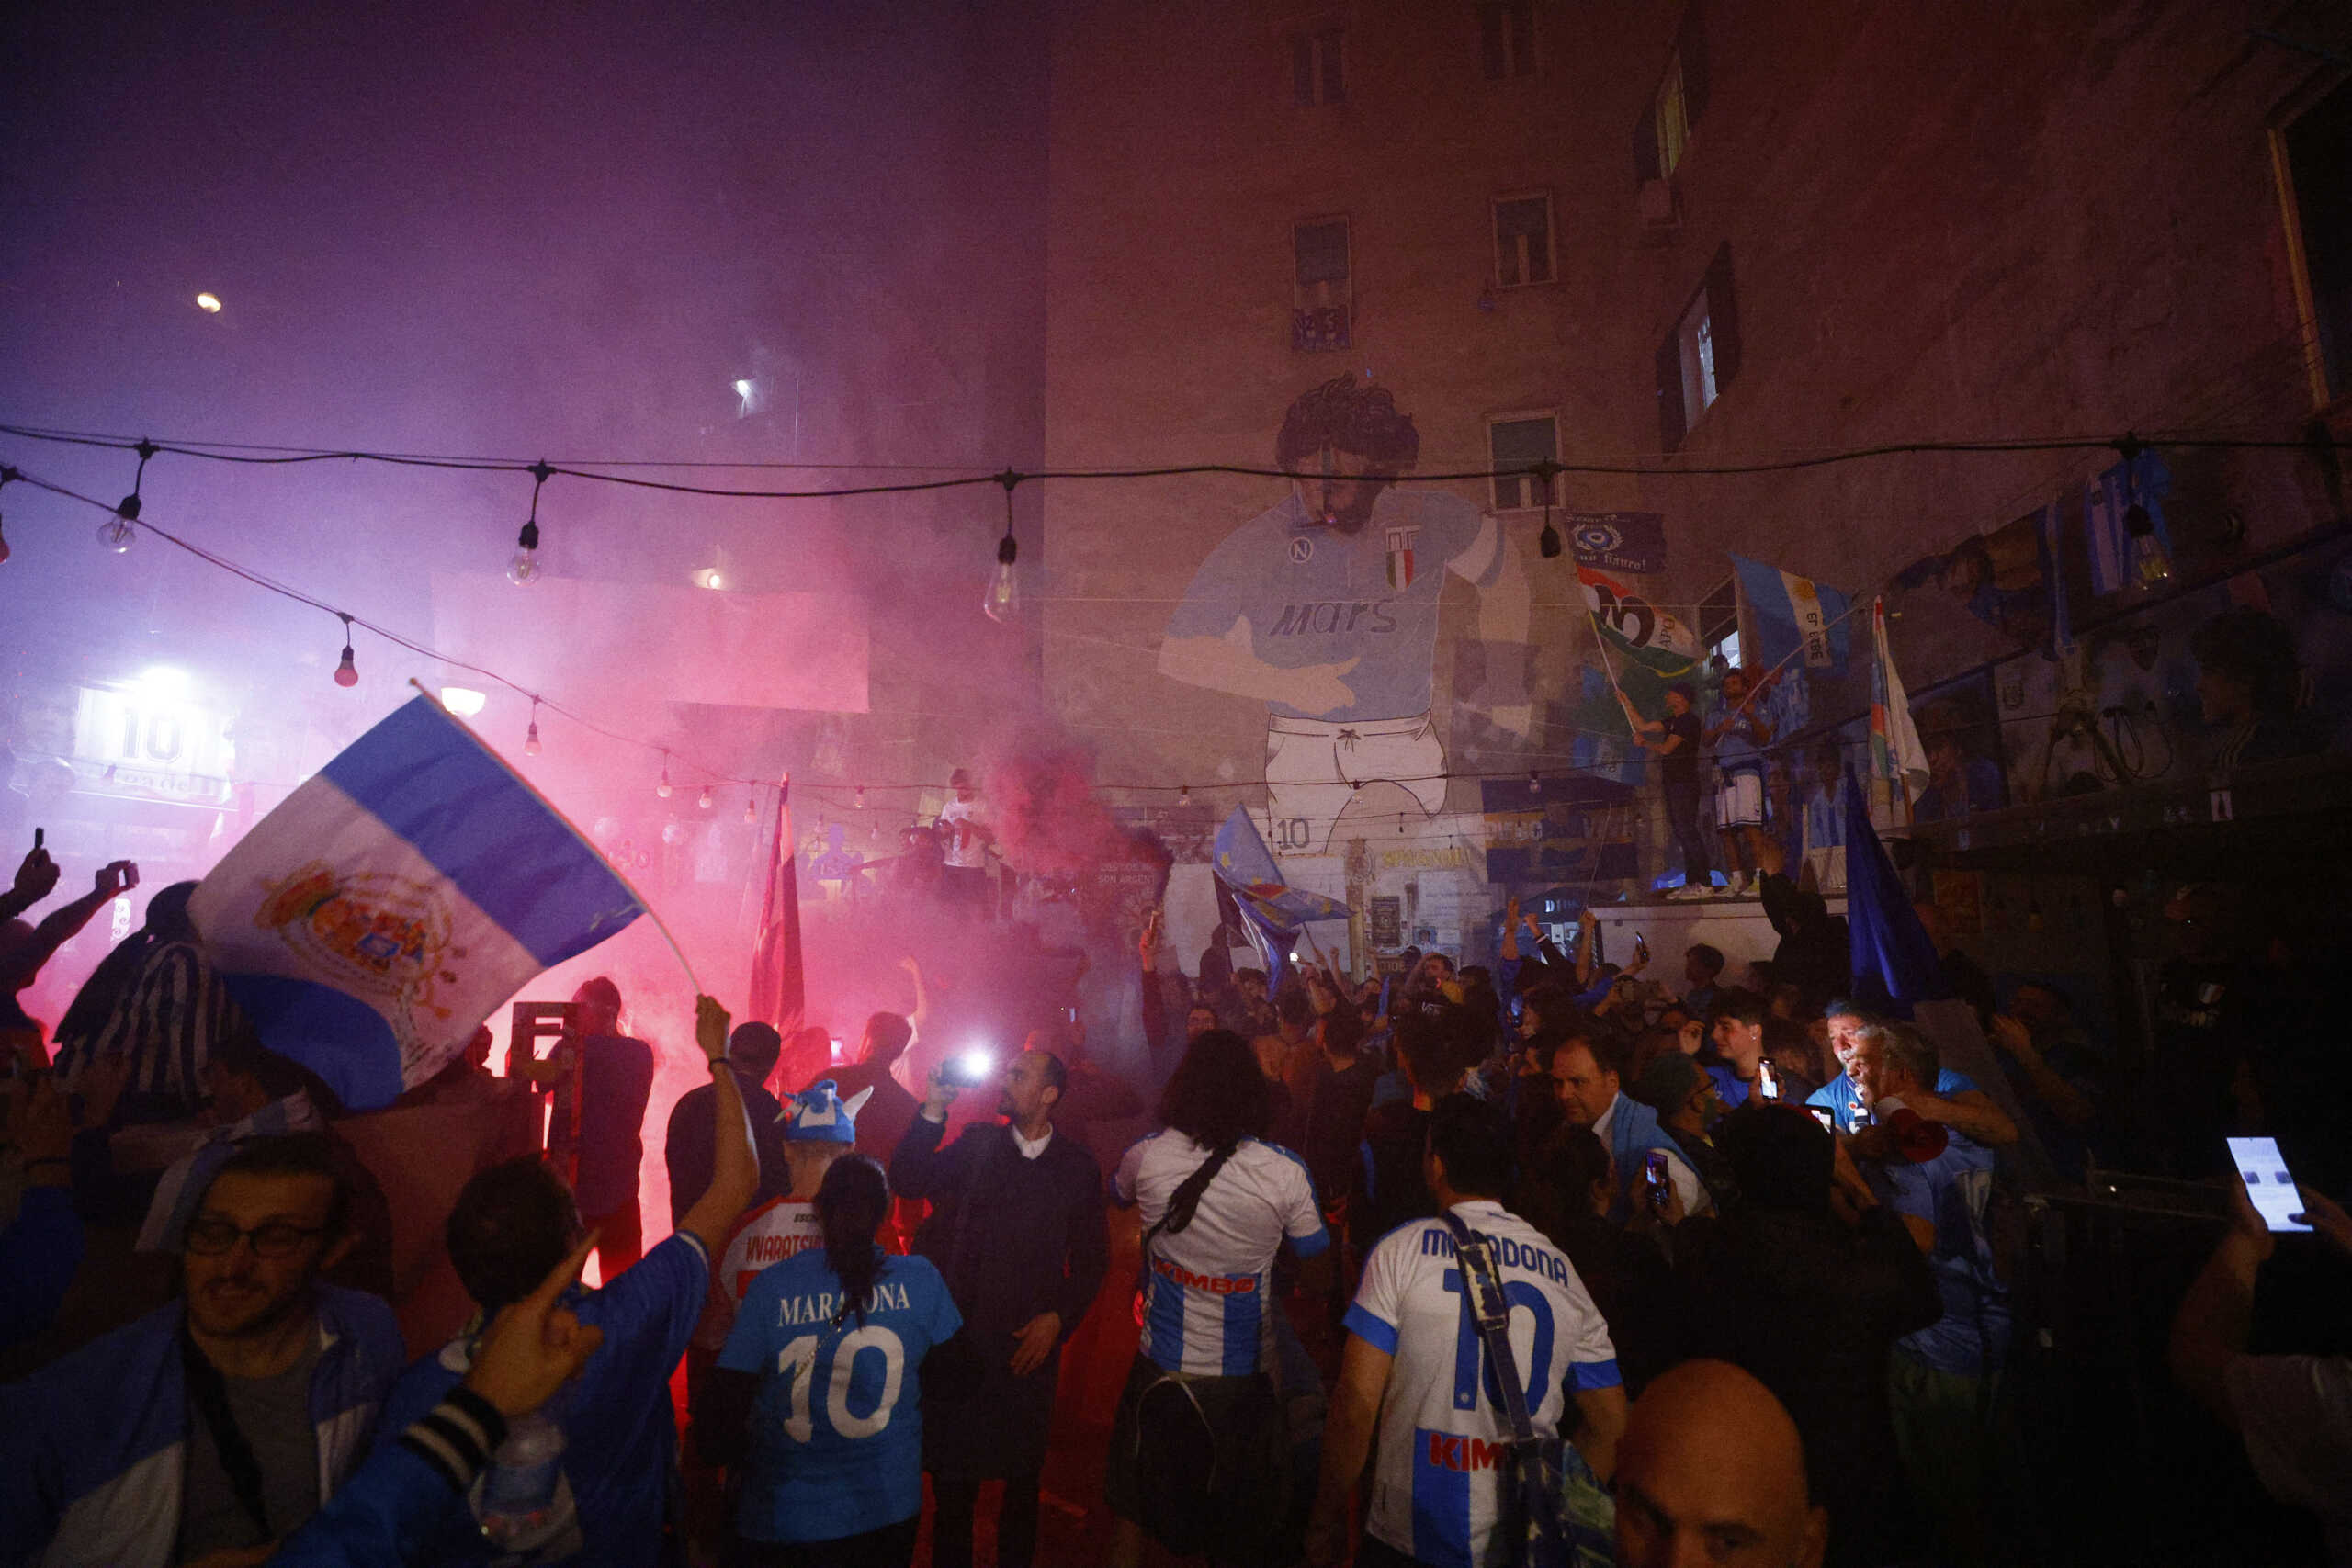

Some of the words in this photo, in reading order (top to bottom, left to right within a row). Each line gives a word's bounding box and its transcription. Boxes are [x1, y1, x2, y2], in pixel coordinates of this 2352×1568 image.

[1277, 818, 1311, 851] 10
[1154, 1258, 1257, 1294] KIMBO
[1422, 1229, 1568, 1288] MAADONA
[777, 1281, 911, 1327] MARAONA
[1442, 1269, 1555, 1417] 10
[778, 1325, 905, 1445] 10
